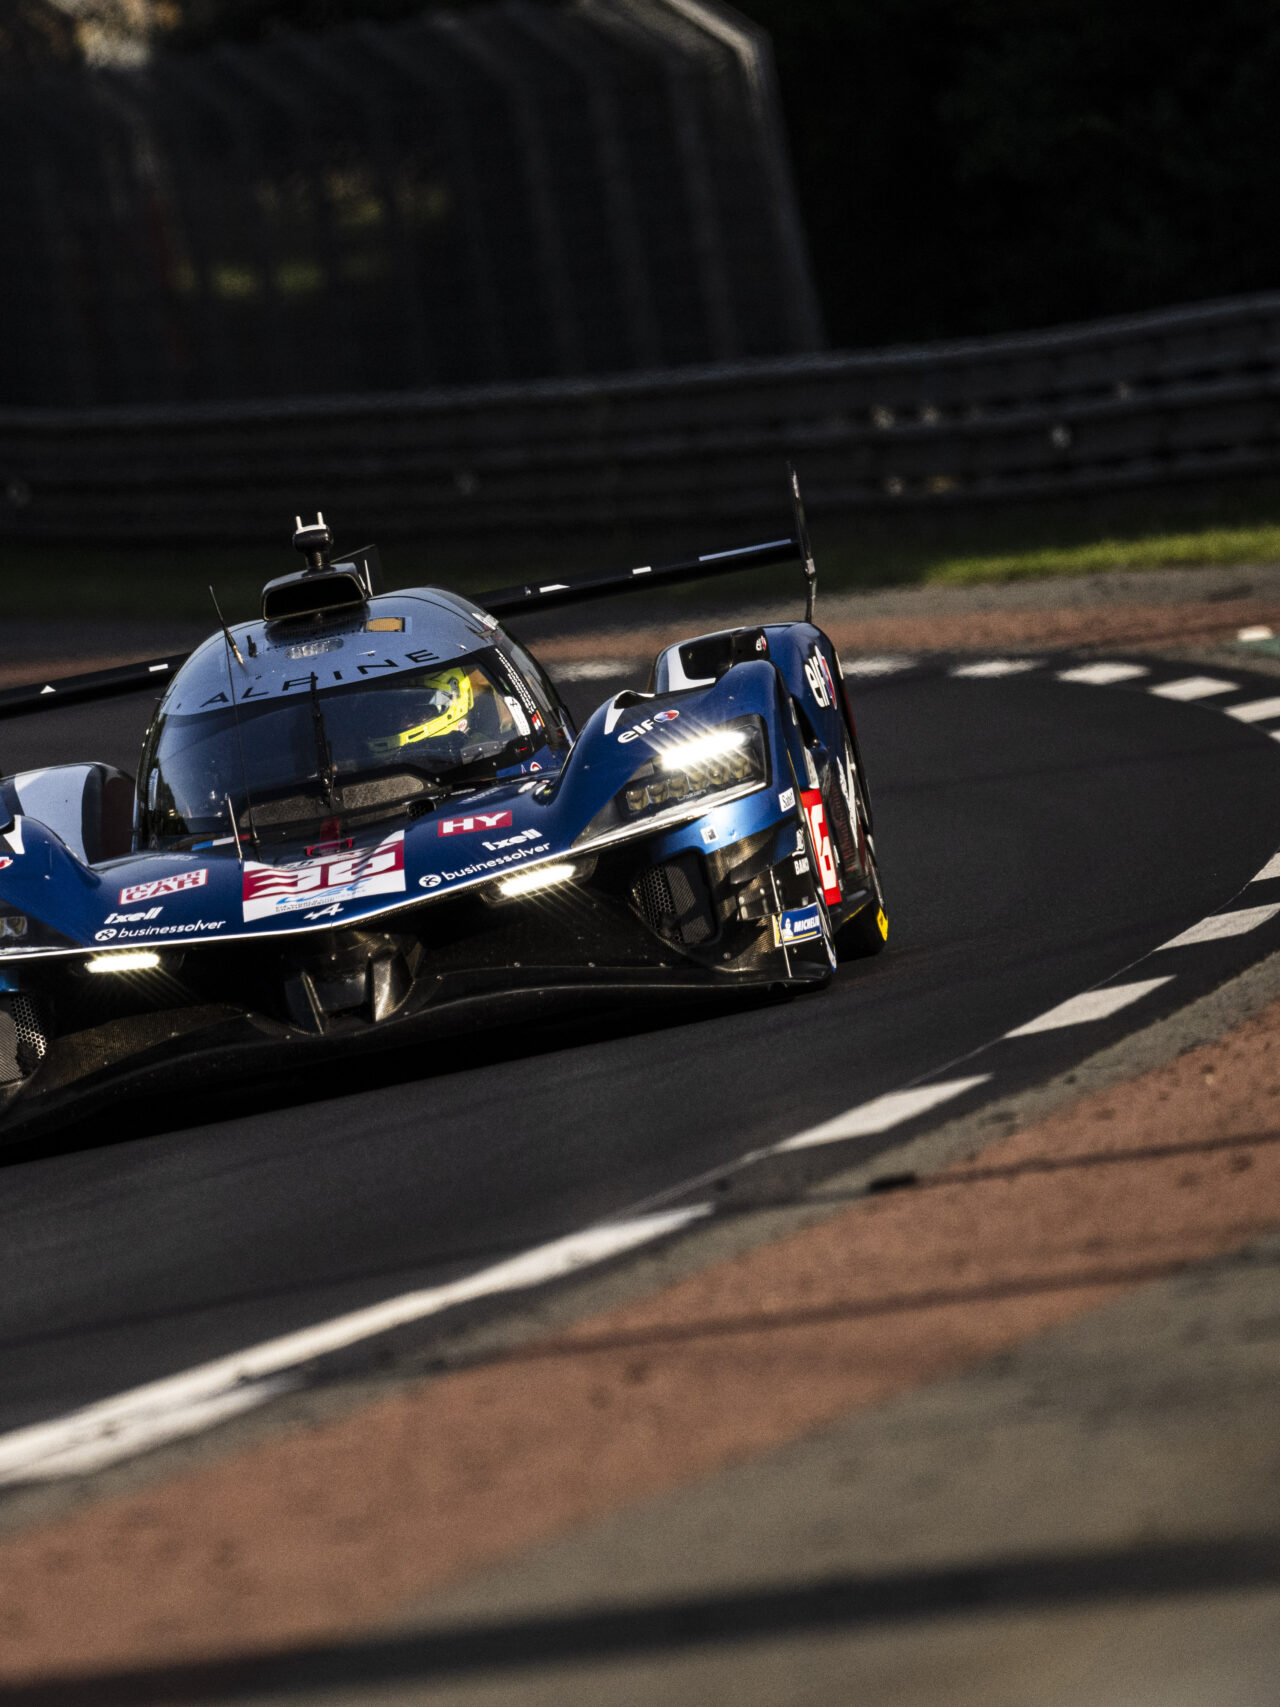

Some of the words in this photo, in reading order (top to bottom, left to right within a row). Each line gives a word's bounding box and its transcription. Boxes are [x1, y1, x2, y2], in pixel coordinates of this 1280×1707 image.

[200, 649, 440, 708] ALPINE
[805, 656, 830, 708] elf
[617, 718, 655, 744] elf
[442, 812, 508, 834] HY
[249, 842, 400, 898] 36
[441, 842, 551, 881] businessolver
[125, 877, 200, 901] CAR
[118, 920, 227, 938] businessolver
